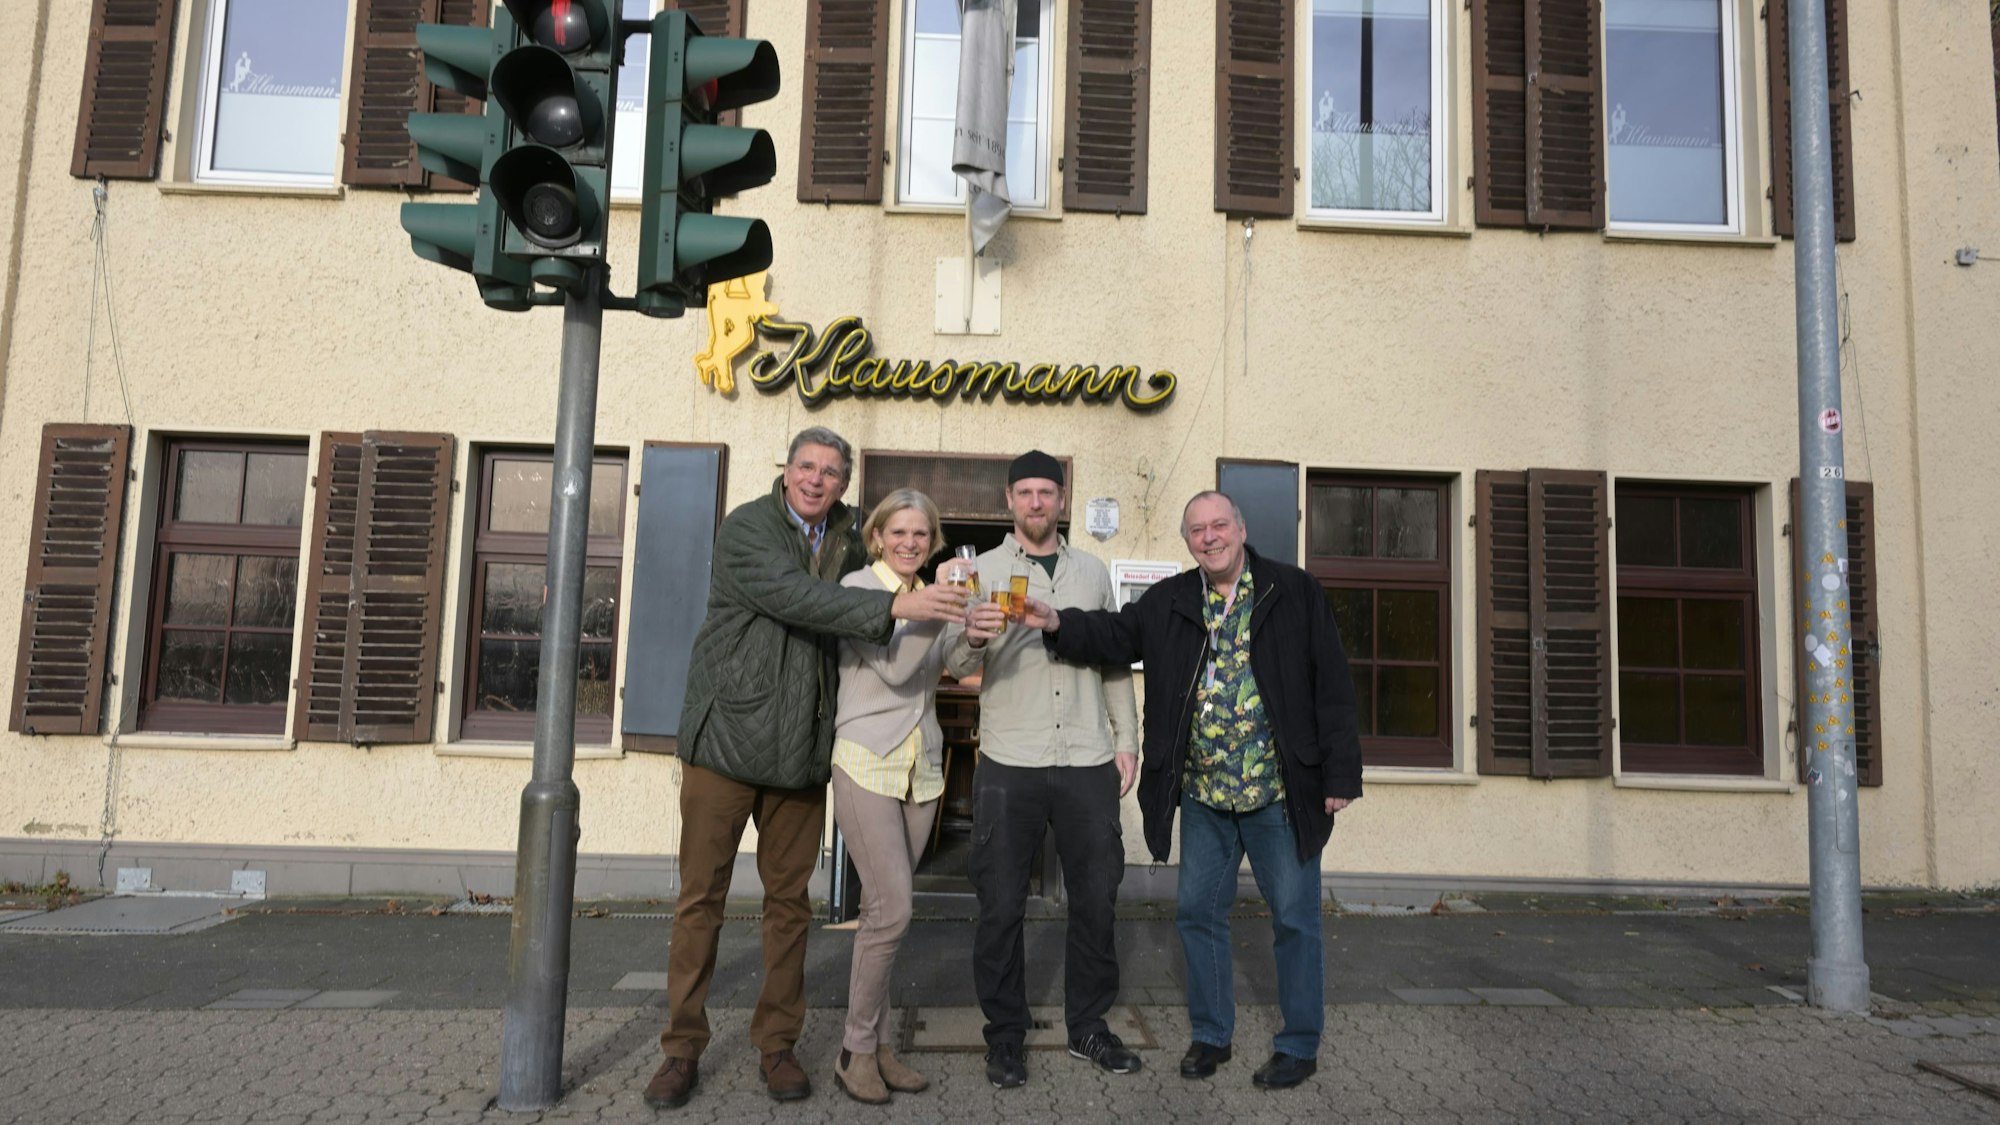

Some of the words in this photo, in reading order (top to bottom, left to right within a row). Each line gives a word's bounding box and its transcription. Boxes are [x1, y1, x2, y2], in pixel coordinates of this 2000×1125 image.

[242, 73, 335, 98] Klausmann
[1621, 123, 1710, 147] Klausmann
[748, 315, 1178, 412] Klausmann
